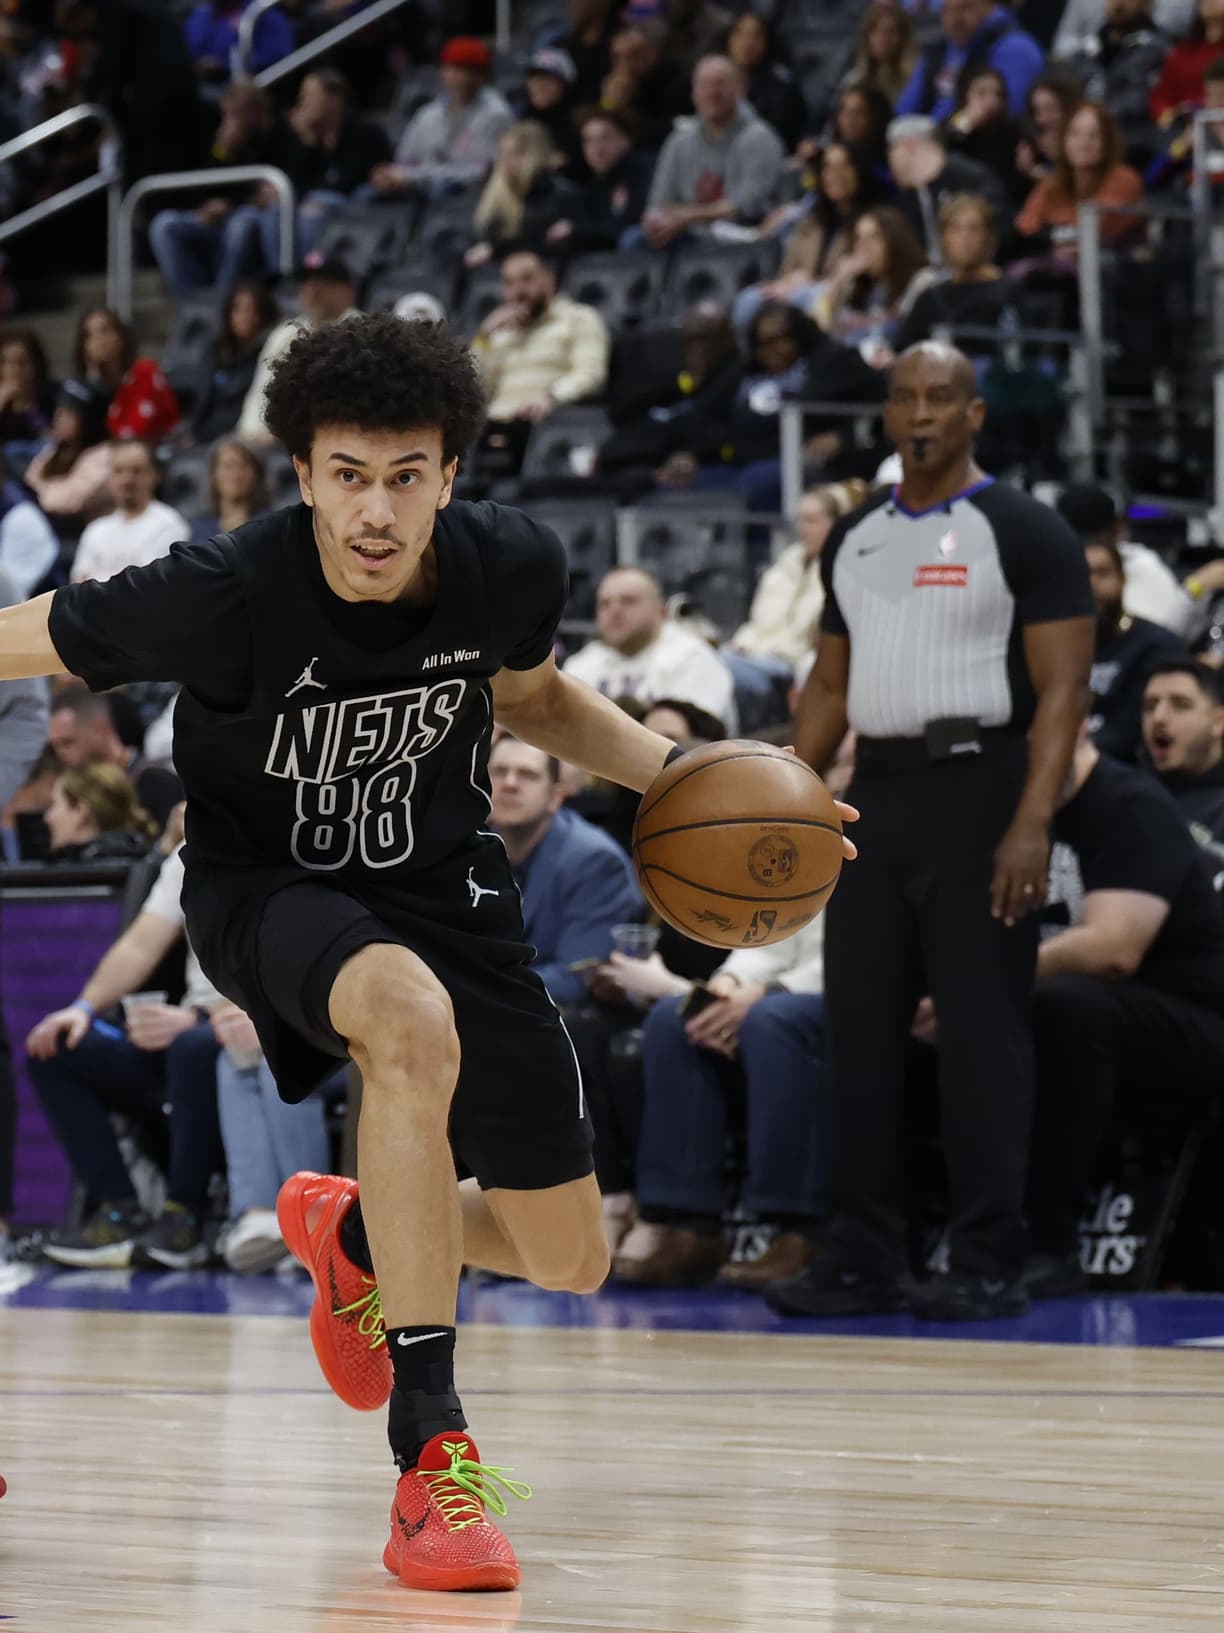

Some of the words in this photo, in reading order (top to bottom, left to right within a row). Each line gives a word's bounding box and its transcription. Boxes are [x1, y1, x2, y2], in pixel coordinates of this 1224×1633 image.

[422, 654, 438, 670] All
[440, 652, 452, 666] In
[454, 649, 480, 663] Won
[264, 678, 467, 784] NETS
[291, 759, 417, 871] 88
